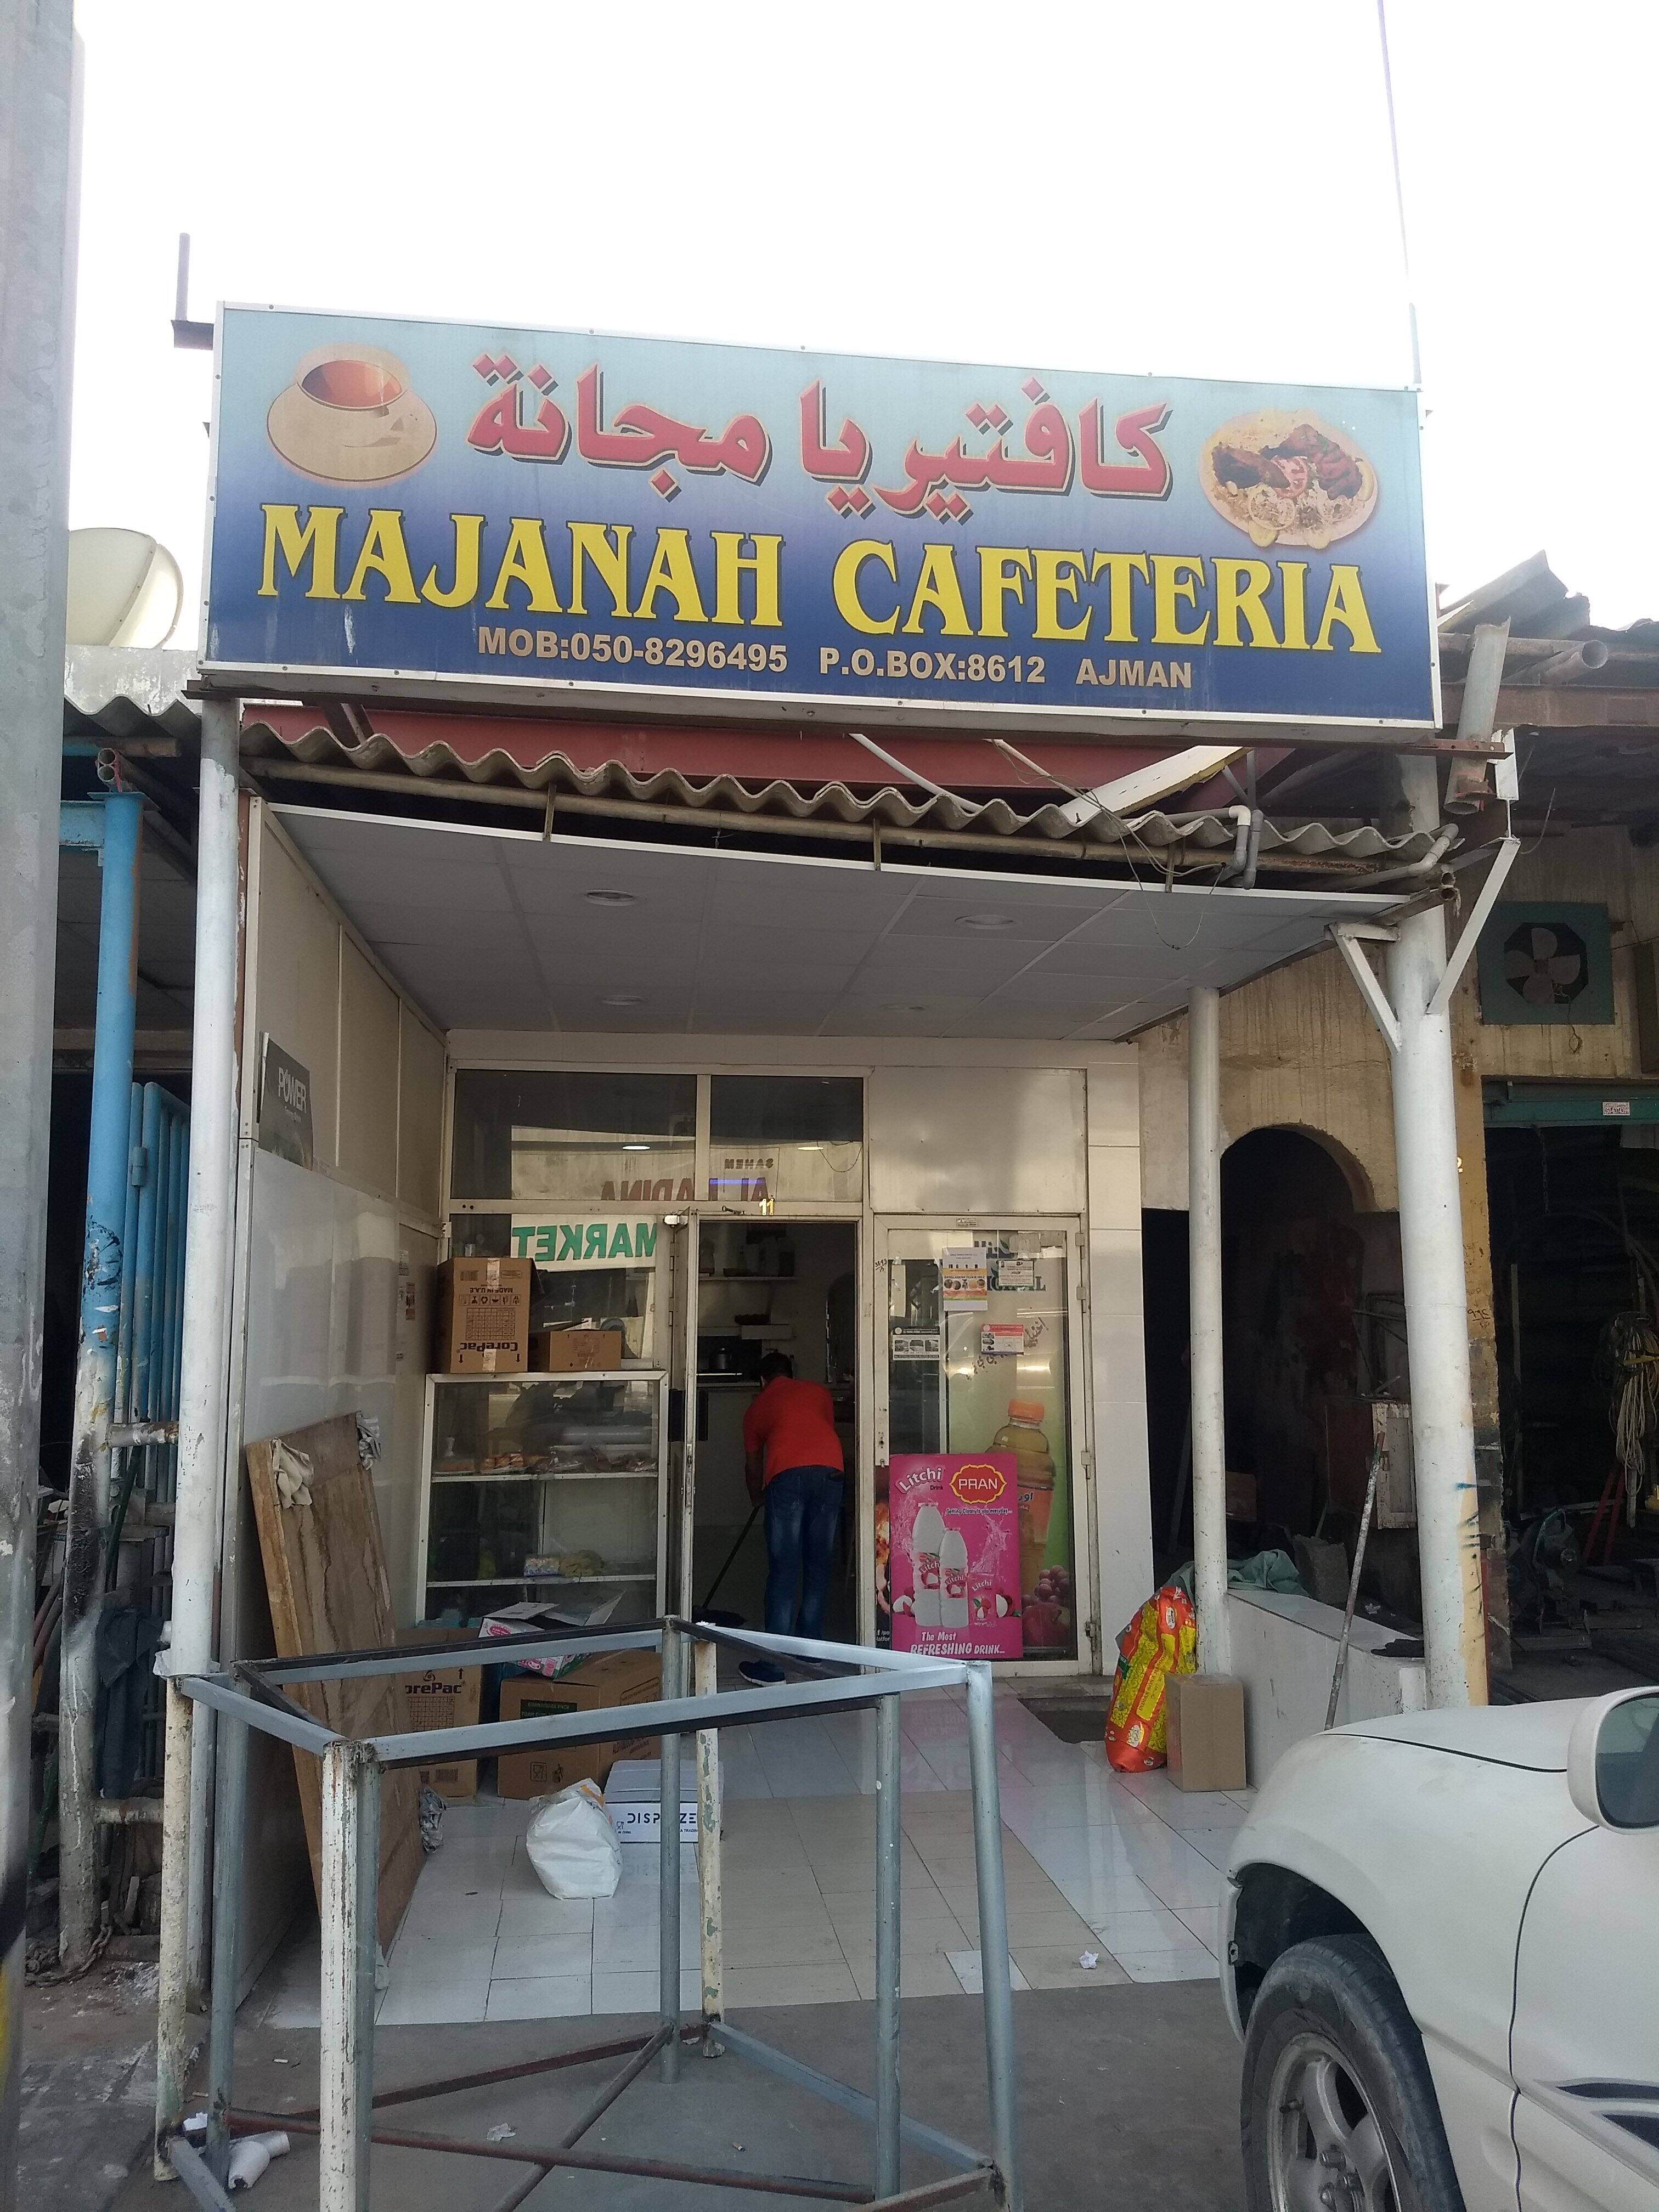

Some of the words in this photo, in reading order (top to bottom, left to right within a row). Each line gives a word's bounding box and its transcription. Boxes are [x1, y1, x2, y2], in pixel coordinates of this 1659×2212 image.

[468, 353, 770, 496] مجانة
[799, 377, 1169, 521] كافتيريا
[258, 504, 784, 627] MAJANAH
[832, 539, 1381, 653] CAFETERIA
[478, 626, 788, 672] MOB:050-8296495
[819, 647, 1046, 683] P.O.BOX:8612
[1075, 658, 1192, 689] AJMAN
[460, 1342, 518, 1352] CorePac
[899, 1467, 943, 1492] Litchi
[958, 1478, 998, 1491] PRAN
[920, 1561, 940, 1573] Litch
[972, 1579, 992, 1592] Litchi
[921, 1632, 934, 1641] The
[937, 1632, 956, 1641] Most
[910, 1642, 973, 1655] REFRESHING
[405, 1682, 462, 1694] orePac
[627, 1813, 697, 1824] DISPZE
